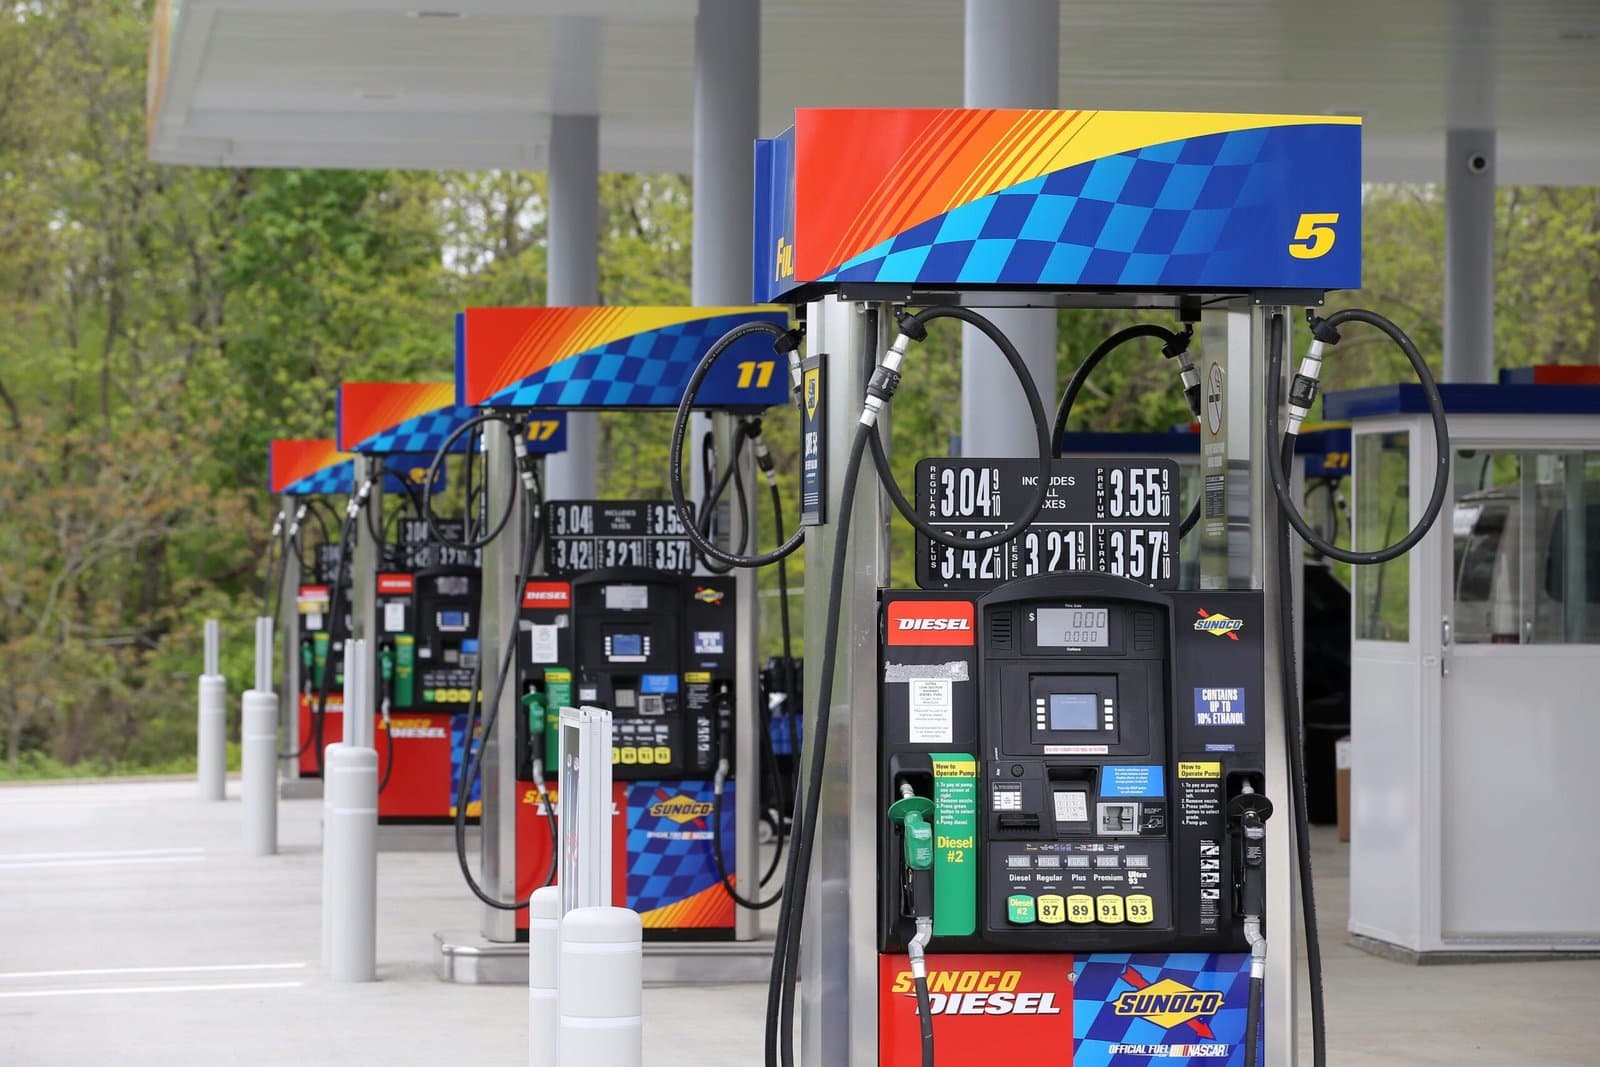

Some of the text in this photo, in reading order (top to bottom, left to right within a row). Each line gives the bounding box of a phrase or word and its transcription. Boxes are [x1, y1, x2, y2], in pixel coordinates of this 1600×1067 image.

[1288, 213, 1339, 260] 5
[736, 360, 775, 388] 11
[528, 420, 560, 440] 17
[1021, 476, 1076, 486] INCUDES
[941, 468, 991, 517] 3.04
[1110, 468, 1161, 517] 3.55
[1041, 499, 1066, 509] XES
[1011, 536, 1019, 578] IESEL
[1110, 529, 1163, 579] 3.57
[1028, 612, 1035, 622] $
[895, 618, 970, 631] DIESEL
[1194, 619, 1242, 630] SUNOCO
[1202, 689, 1238, 701] CONTAINS
[1209, 701, 1231, 712] UP TO
[1197, 712, 1245, 725] 10% ETHANOL
[653, 804, 711, 815] SUNOCO
[937, 836, 973, 849] Diesel
[946, 850, 964, 863] #2
[1008, 873, 1031, 882] Diesel
[1036, 873, 1063, 883] Regular
[1071, 873, 1087, 882] Plus
[1093, 873, 1124, 882] Premium
[1128, 870, 1148, 879] Ultra
[1010, 898, 1034, 906] Diesel
[1016, 907, 1028, 915] #2
[1042, 905, 1059, 916] 87
[1071, 905, 1089, 916] 89
[1101, 905, 1119, 916] 91
[1130, 905, 1148, 916] 93
[904, 992, 1061, 1015] DIESEL
[1118, 993, 1223, 1015] SUNOCO
[1108, 1044, 1169, 1055] OFFICIAL FUEL
[1187, 1044, 1227, 1057] NASCAR
